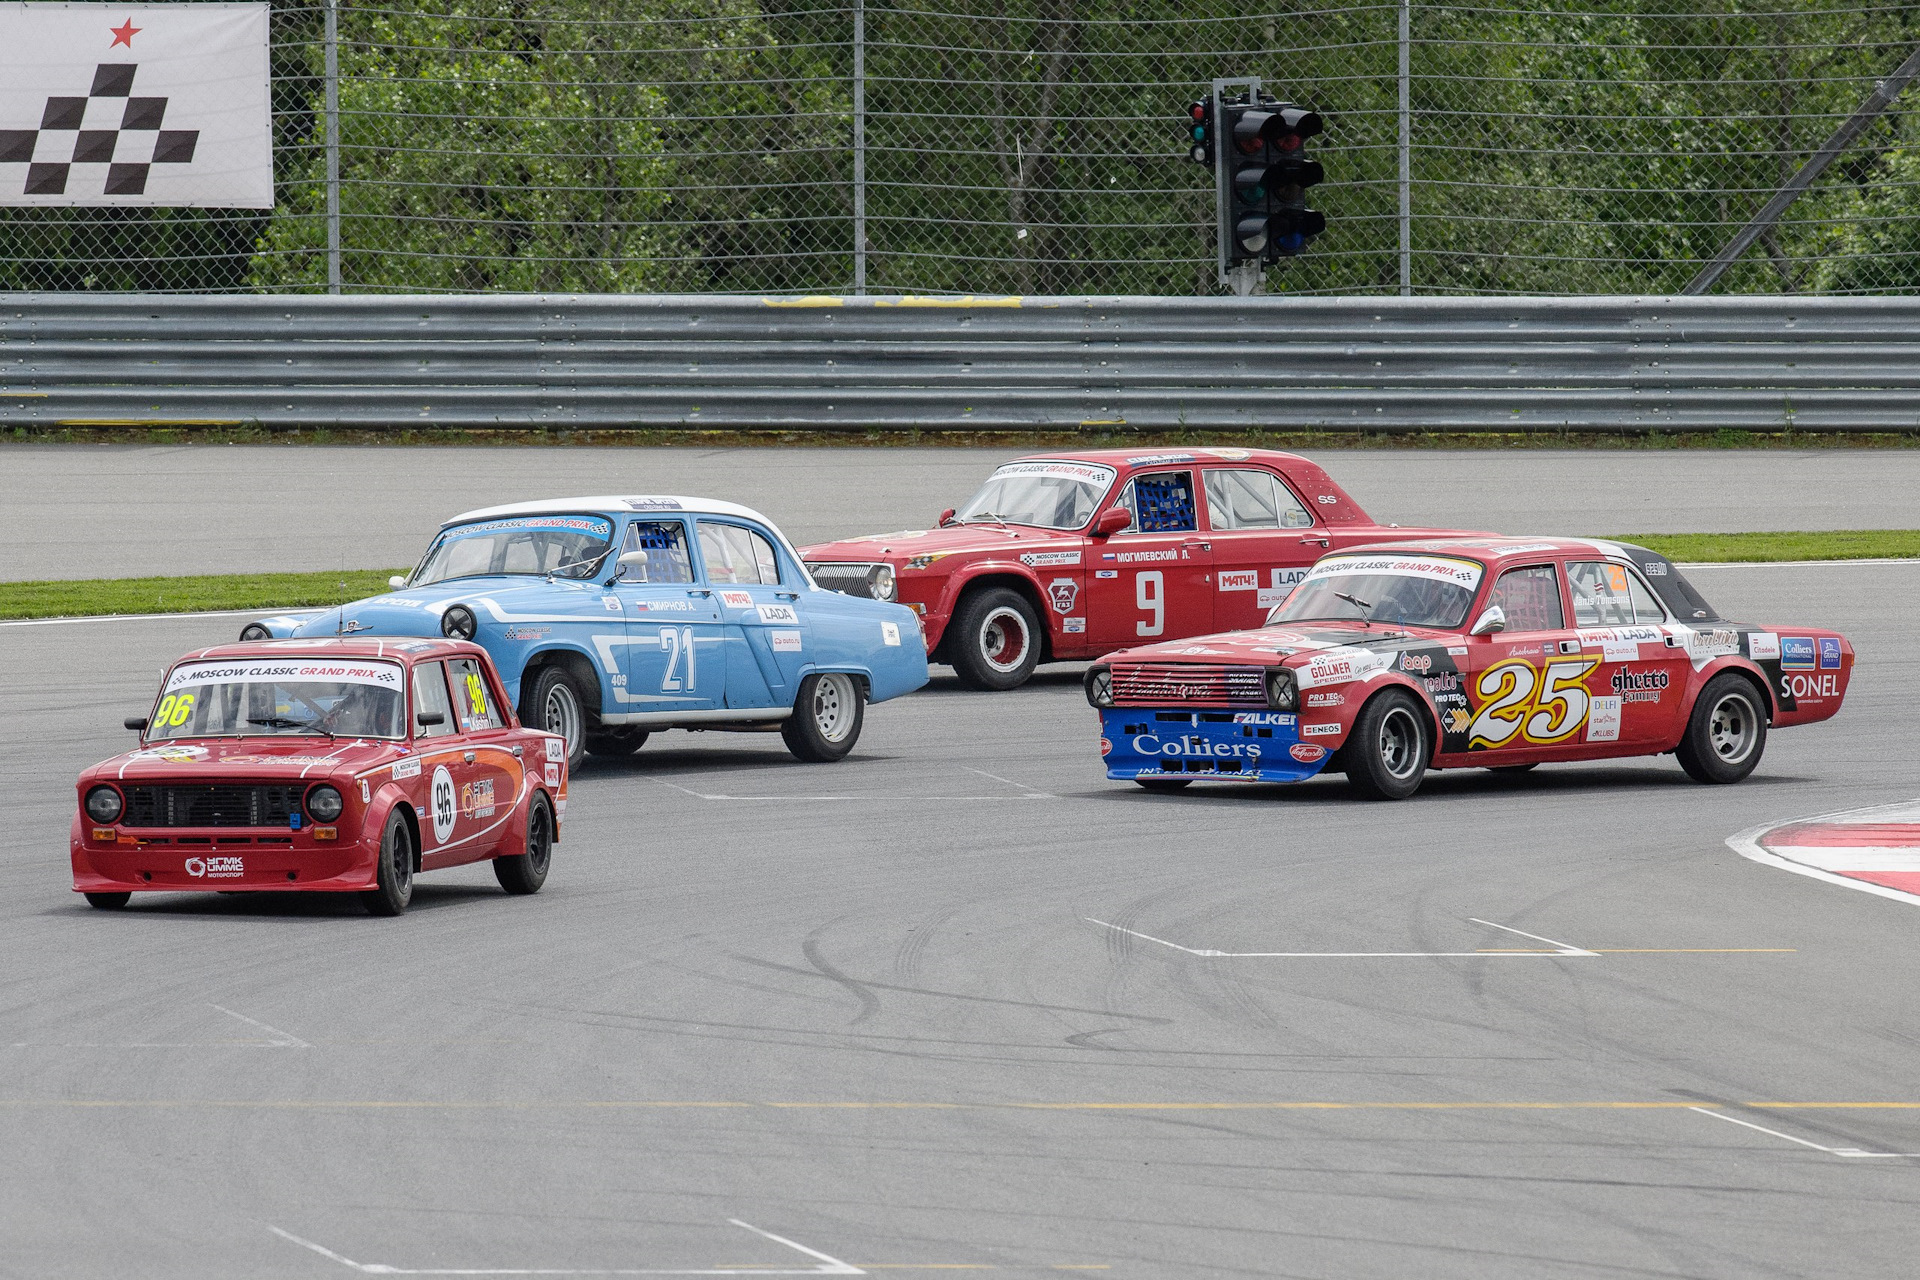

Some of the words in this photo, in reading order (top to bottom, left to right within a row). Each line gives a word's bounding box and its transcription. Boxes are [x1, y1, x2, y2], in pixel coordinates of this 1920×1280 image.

[995, 466, 1019, 476] OSCOW
[1020, 465, 1048, 474] CLASSIC
[1047, 465, 1072, 474] GRAND
[1073, 468, 1093, 477] PRIX
[1318, 495, 1337, 504] SS
[485, 520, 526, 530] CLASSIC
[526, 518, 564, 527] GRAND
[565, 520, 593, 530] PRIX
[1117, 548, 1178, 563] МОГИЛЕВСКИЙ
[1181, 550, 1190, 560] Л.
[1316, 563, 1354, 574] MOSCOW
[1355, 562, 1395, 570] CLASSIC
[1393, 562, 1432, 572] GRAND
[1432, 565, 1457, 577] PRIX
[1222, 575, 1255, 586] МАТЧ!
[1607, 565, 1627, 592] 25
[647, 601, 687, 612] СМИРНОВ
[1136, 570, 1164, 636] 9
[762, 608, 793, 620] LADA
[1620, 629, 1656, 640] LADA
[1754, 646, 1776, 654] Citadele
[1785, 643, 1812, 654] Colliers
[659, 626, 696, 693] 21
[189, 668, 248, 680] MOSCOW
[249, 667, 298, 676] CLASSIC
[300, 667, 345, 676] GRAND
[348, 669, 377, 678] PRIX
[1611, 664, 1669, 695] ghetto
[611, 674, 628, 686] 409
[1781, 675, 1840, 698] SONEL
[467, 674, 486, 715] 96
[1448, 694, 1460, 702] TEC
[1468, 654, 1604, 749] 25
[1595, 700, 1616, 710] DELFI
[154, 694, 194, 728] 96
[1312, 725, 1339, 733] ENEOS
[1133, 734, 1261, 757] Colliers
[436, 782, 452, 826] 96
